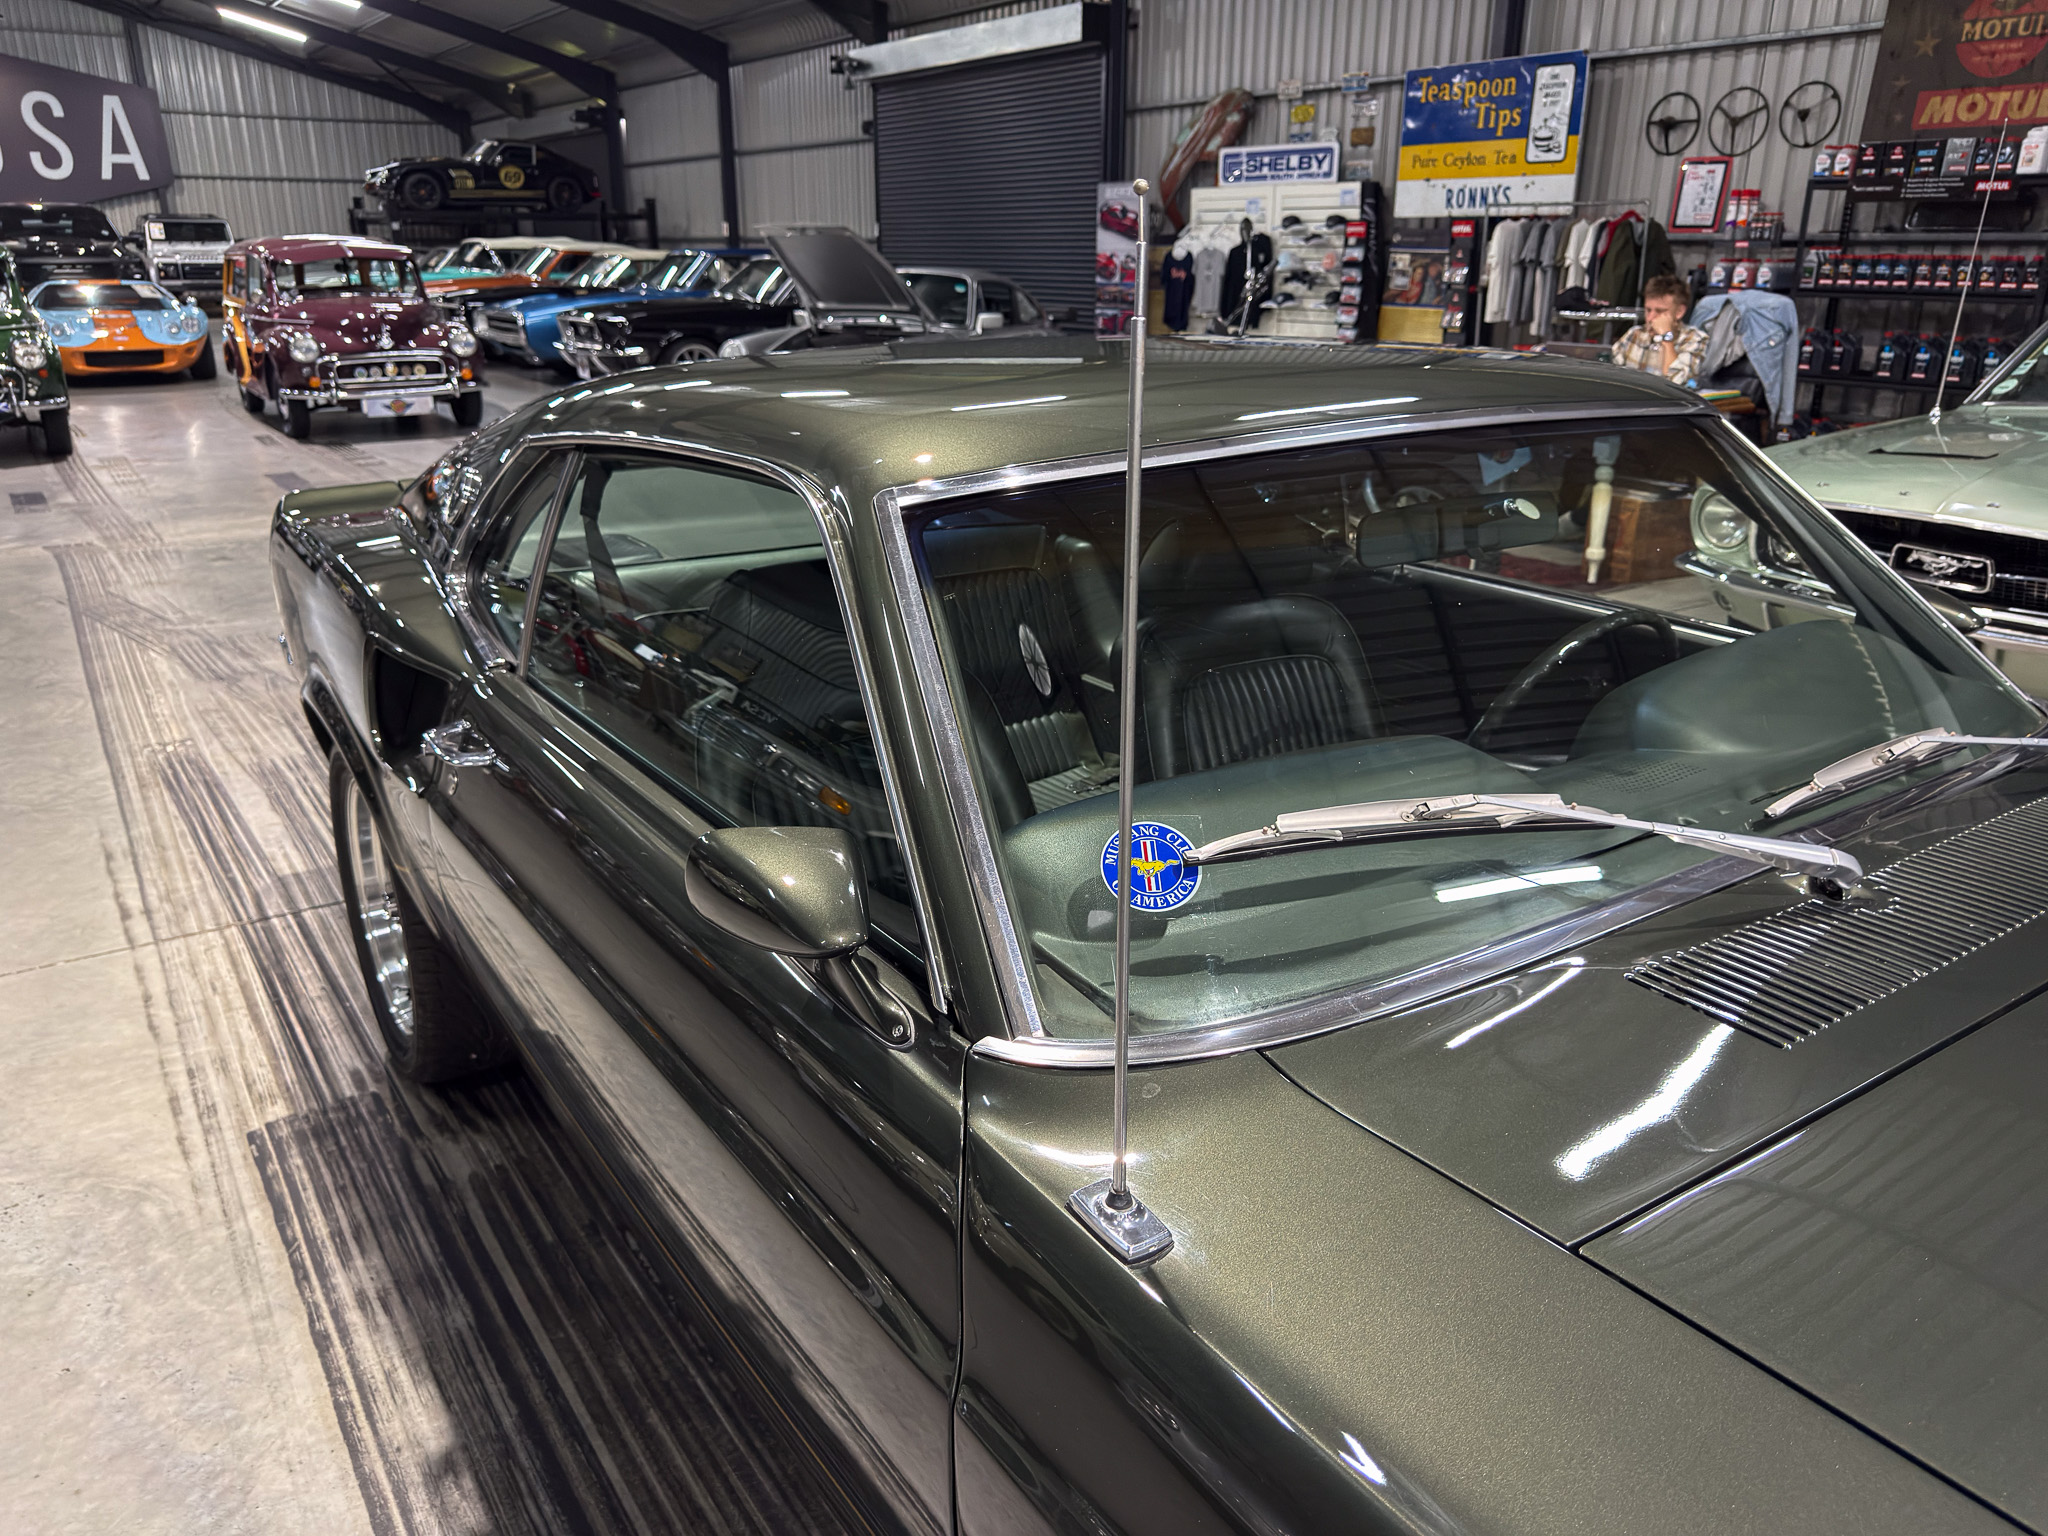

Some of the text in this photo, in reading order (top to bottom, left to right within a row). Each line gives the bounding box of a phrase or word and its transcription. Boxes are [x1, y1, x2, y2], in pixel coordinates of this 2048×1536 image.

[1418, 77, 1517, 107] Teaspoon
[1474, 102, 1522, 137] Tips
[0, 90, 151, 181] SA
[1245, 153, 1328, 173] SHELBY
[1412, 150, 1517, 170] Pure Ceylon Tea
[1445, 186, 1512, 209] RONNYS
[1105, 826, 1159, 866] MUSANG
[1131, 879, 1195, 908] AMERICA
